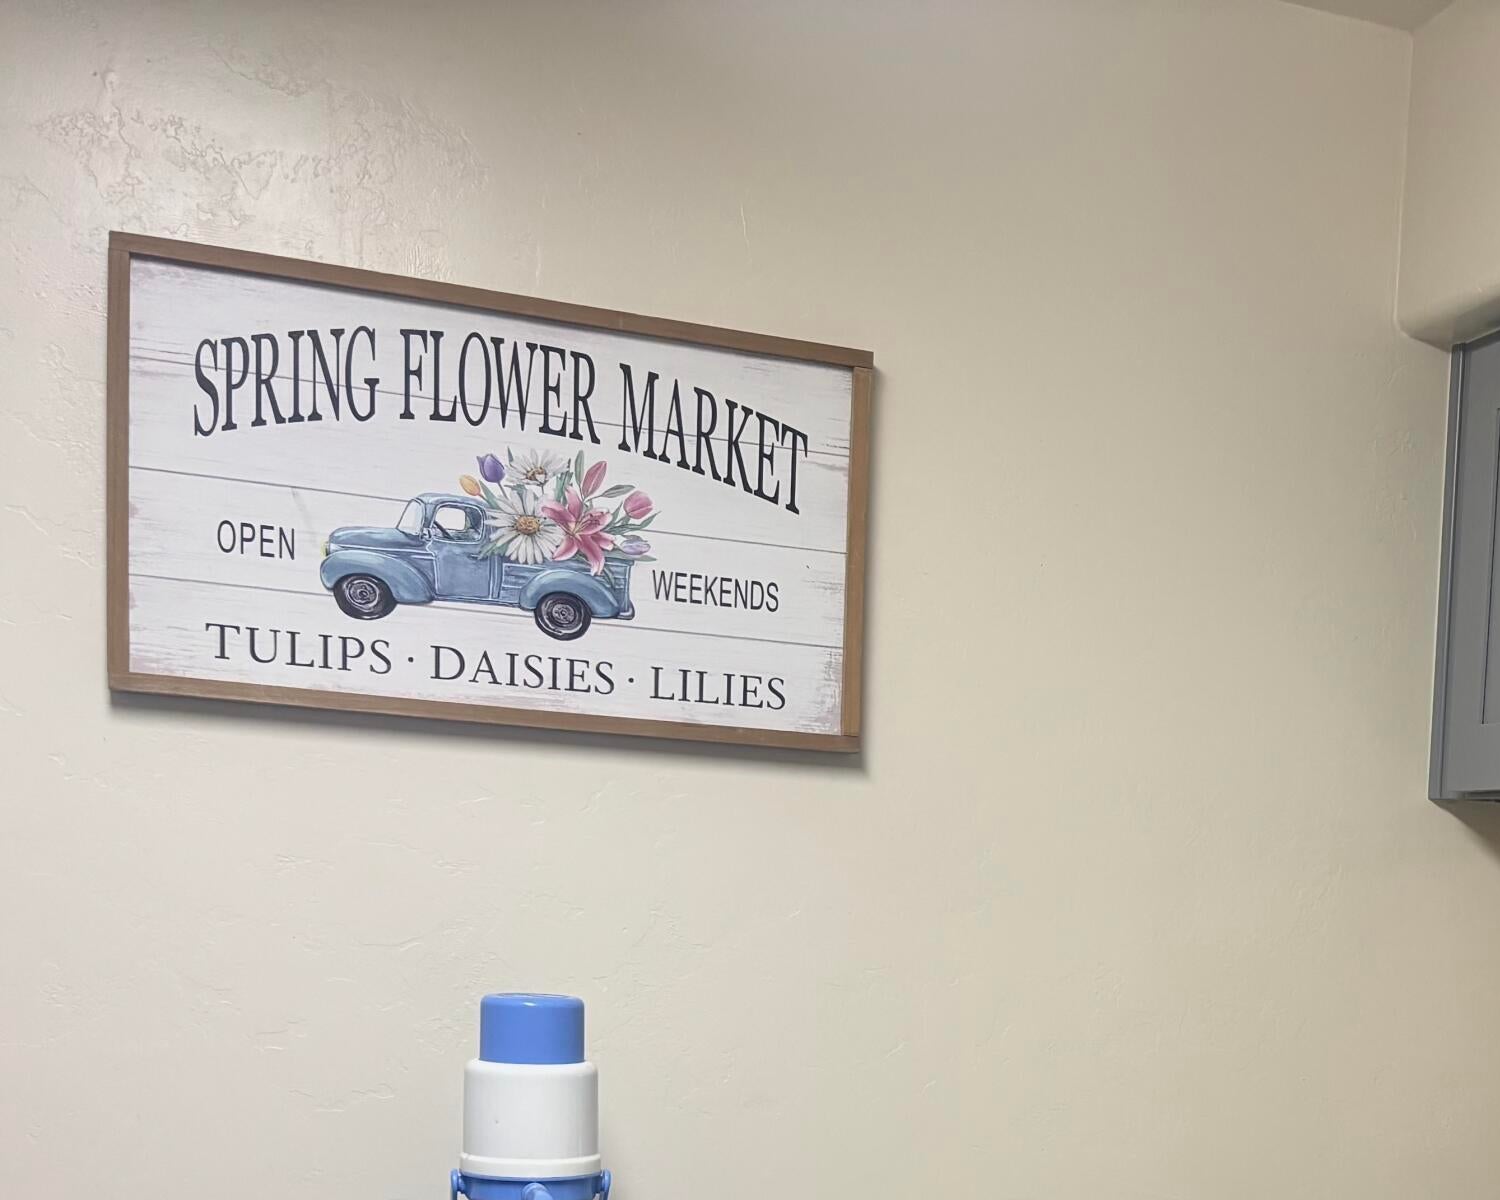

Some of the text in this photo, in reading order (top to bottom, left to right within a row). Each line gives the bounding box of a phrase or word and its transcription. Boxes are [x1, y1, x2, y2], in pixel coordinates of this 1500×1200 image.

[193, 325, 809, 515] SPRING FLOWER MARKET
[216, 518, 779, 612] OPEN WEEKENDS
[205, 620, 787, 711] TULIPS DAISIES LILIES
